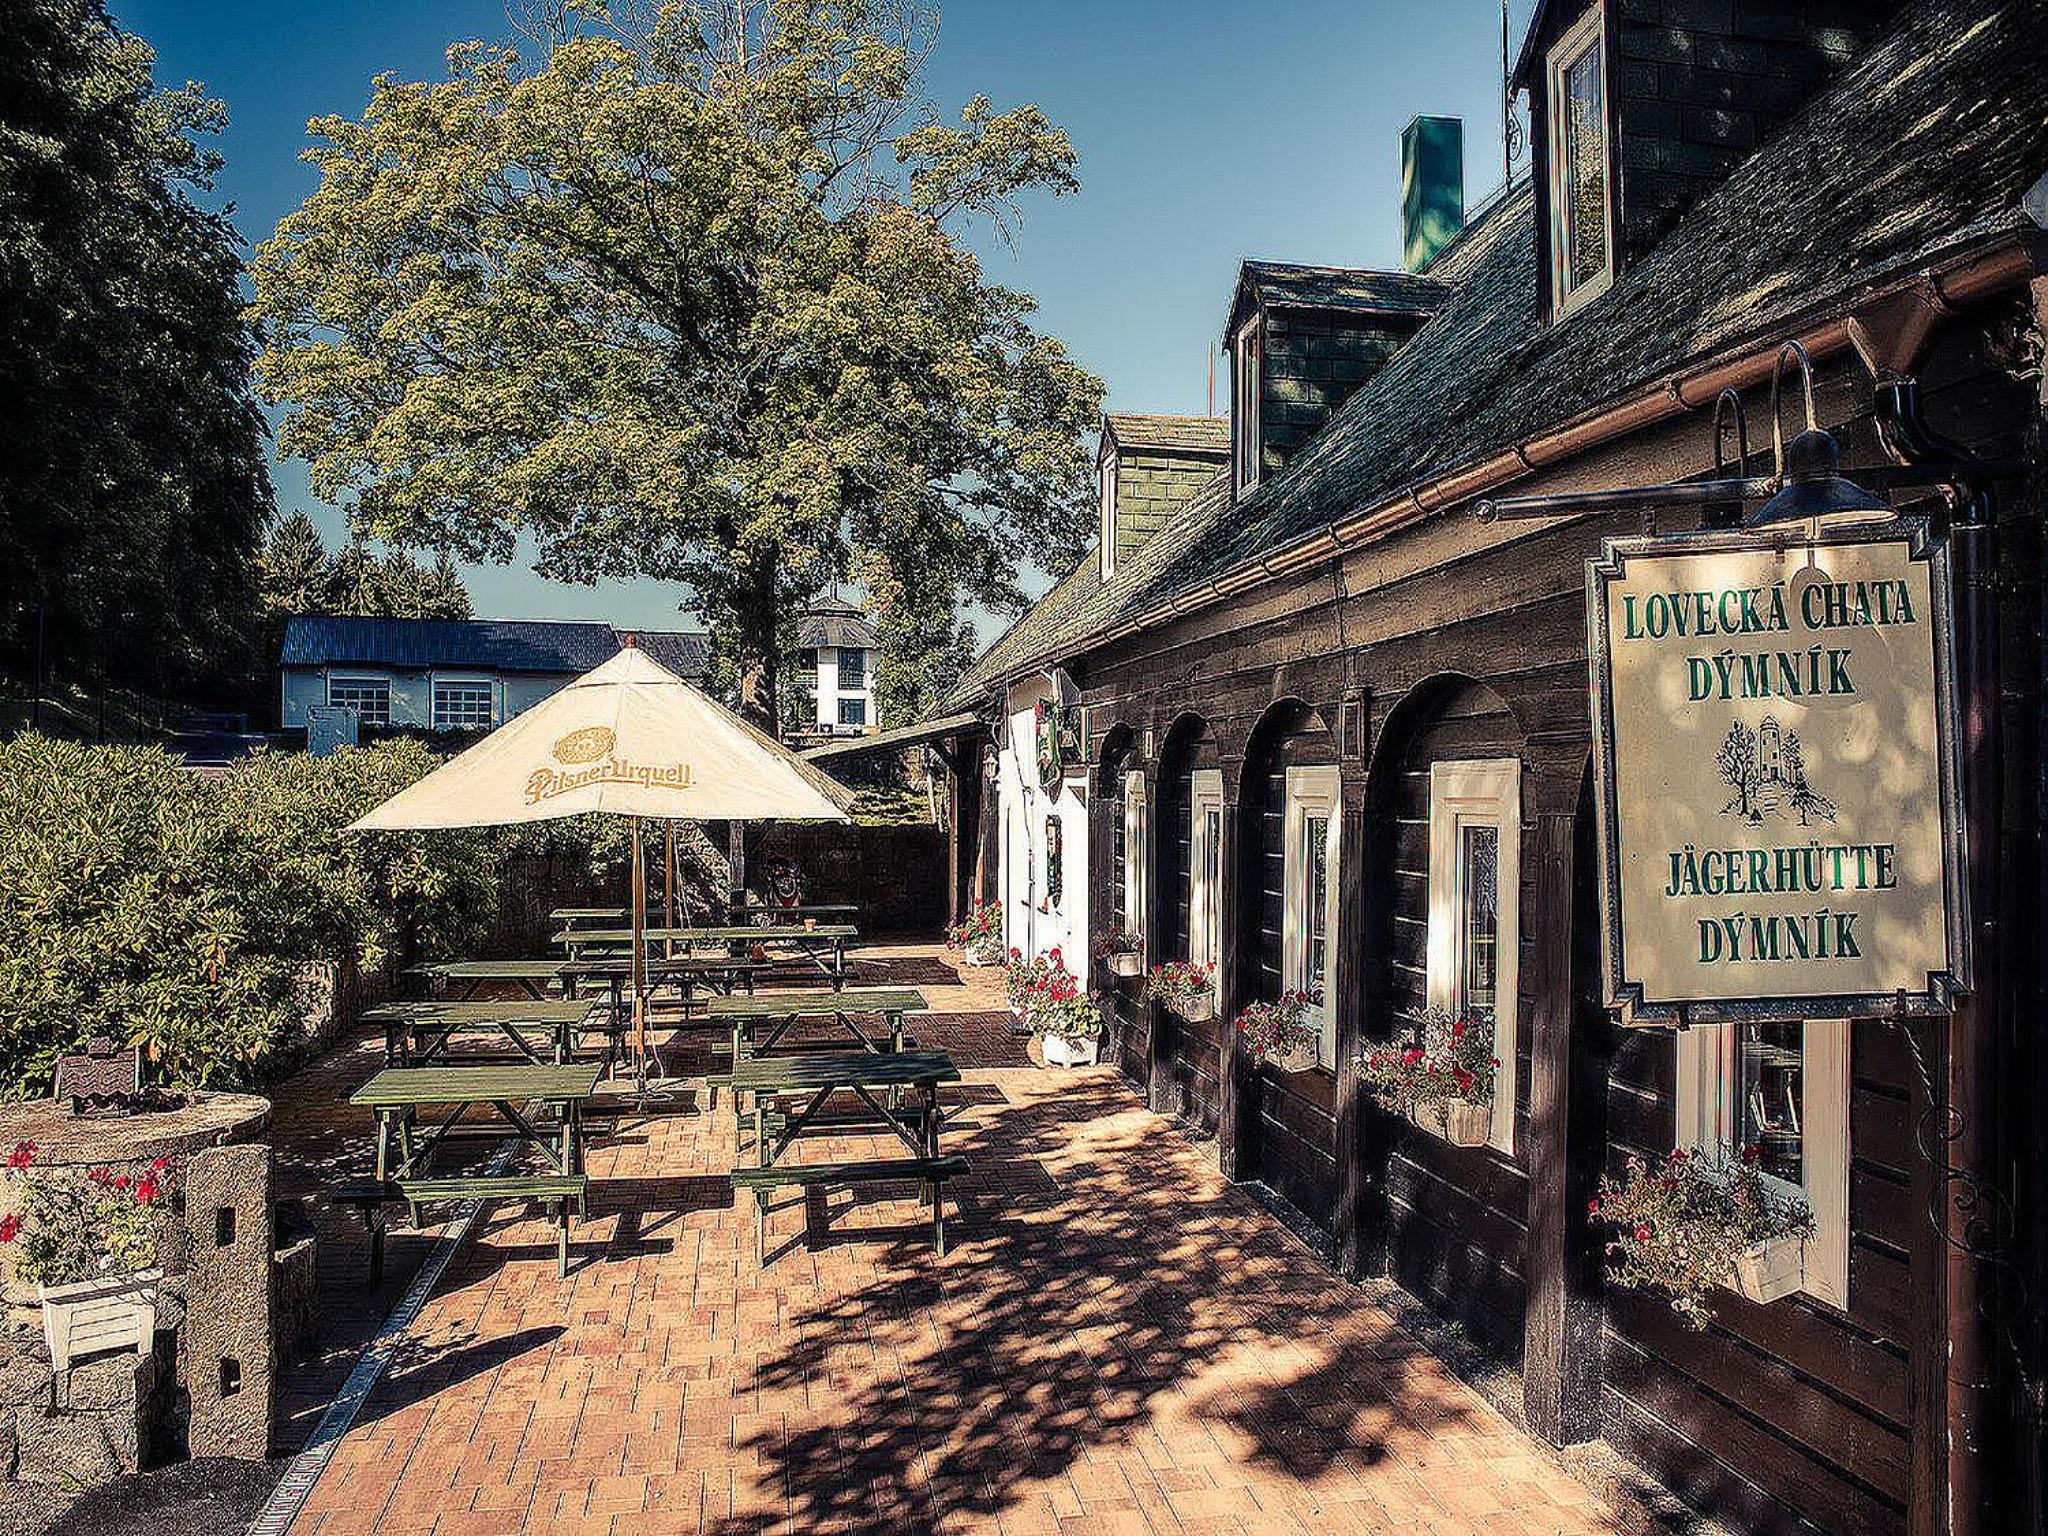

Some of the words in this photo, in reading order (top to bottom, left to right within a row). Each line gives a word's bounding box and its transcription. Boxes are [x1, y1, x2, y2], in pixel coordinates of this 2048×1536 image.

[1624, 580, 1790, 640] LOVECKÁ
[1801, 579, 1917, 631] CHATA
[1687, 648, 1855, 702] DÝMNÍK
[525, 764, 611, 805] Pilsner
[1665, 841, 1898, 897] JÄGERHÜTTE
[1698, 908, 1862, 964] DÝMNÍK
